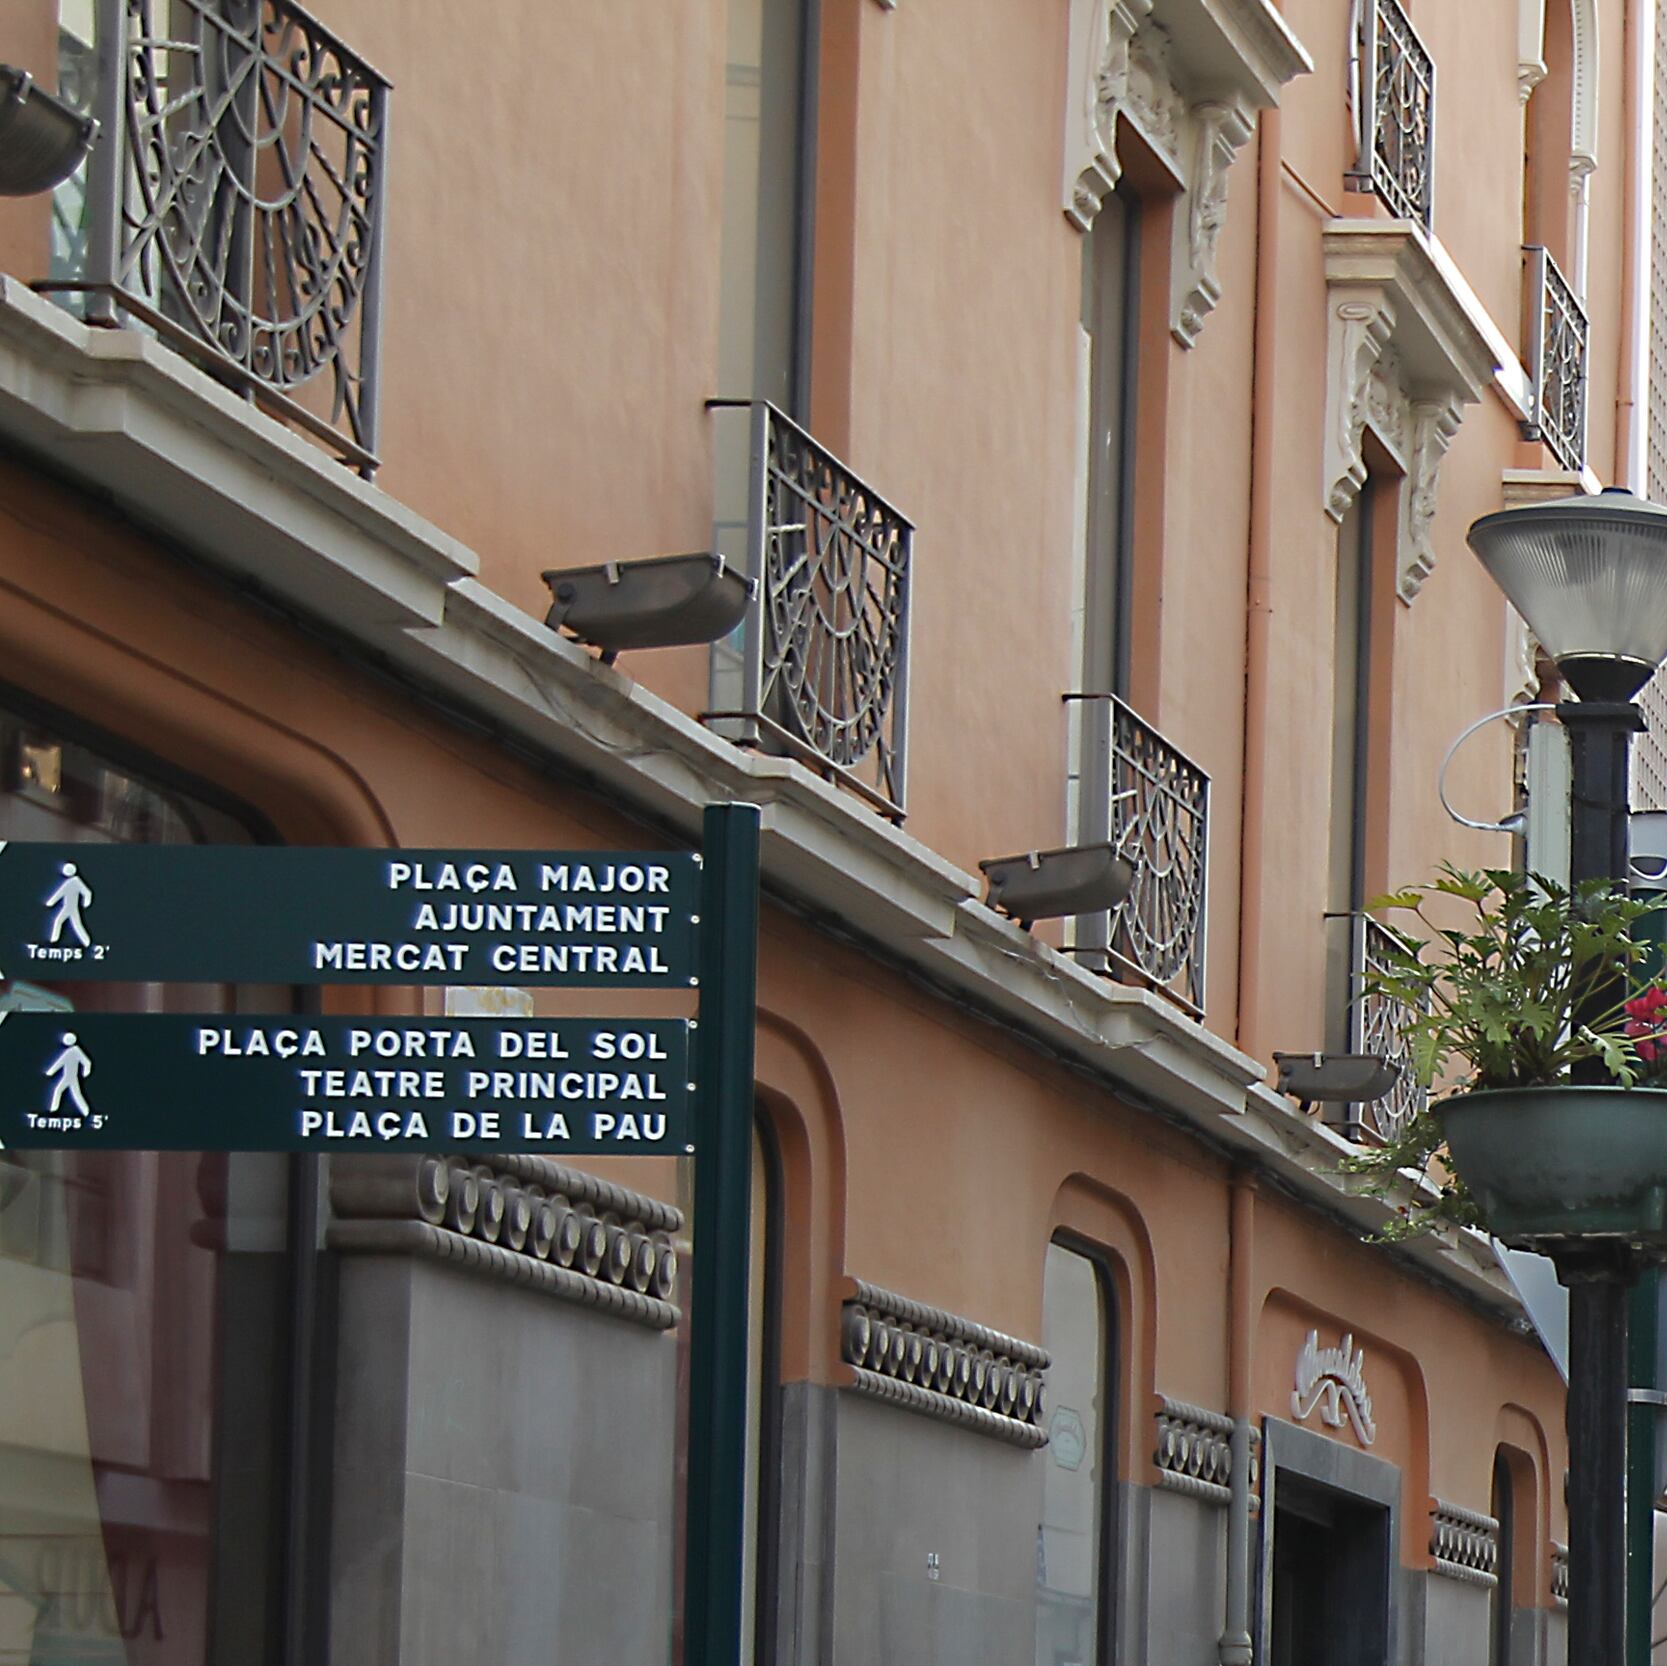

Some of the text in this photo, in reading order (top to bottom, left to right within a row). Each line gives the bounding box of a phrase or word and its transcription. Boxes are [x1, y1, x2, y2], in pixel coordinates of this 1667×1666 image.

[389, 863, 670, 893] PLAÇA MAJOR
[414, 905, 670, 933] AJUNTAMENT
[27, 944, 83, 962] Temps
[315, 943, 669, 973] MERCAT CENTRAL
[199, 1029, 667, 1059] PLAÇA PORTA DEL SOL
[300, 1070, 666, 1099] TEATRE PRINCIPAL
[27, 1114, 82, 1132] Temps
[301, 1111, 666, 1141] PLAÇA DE LA PAU
